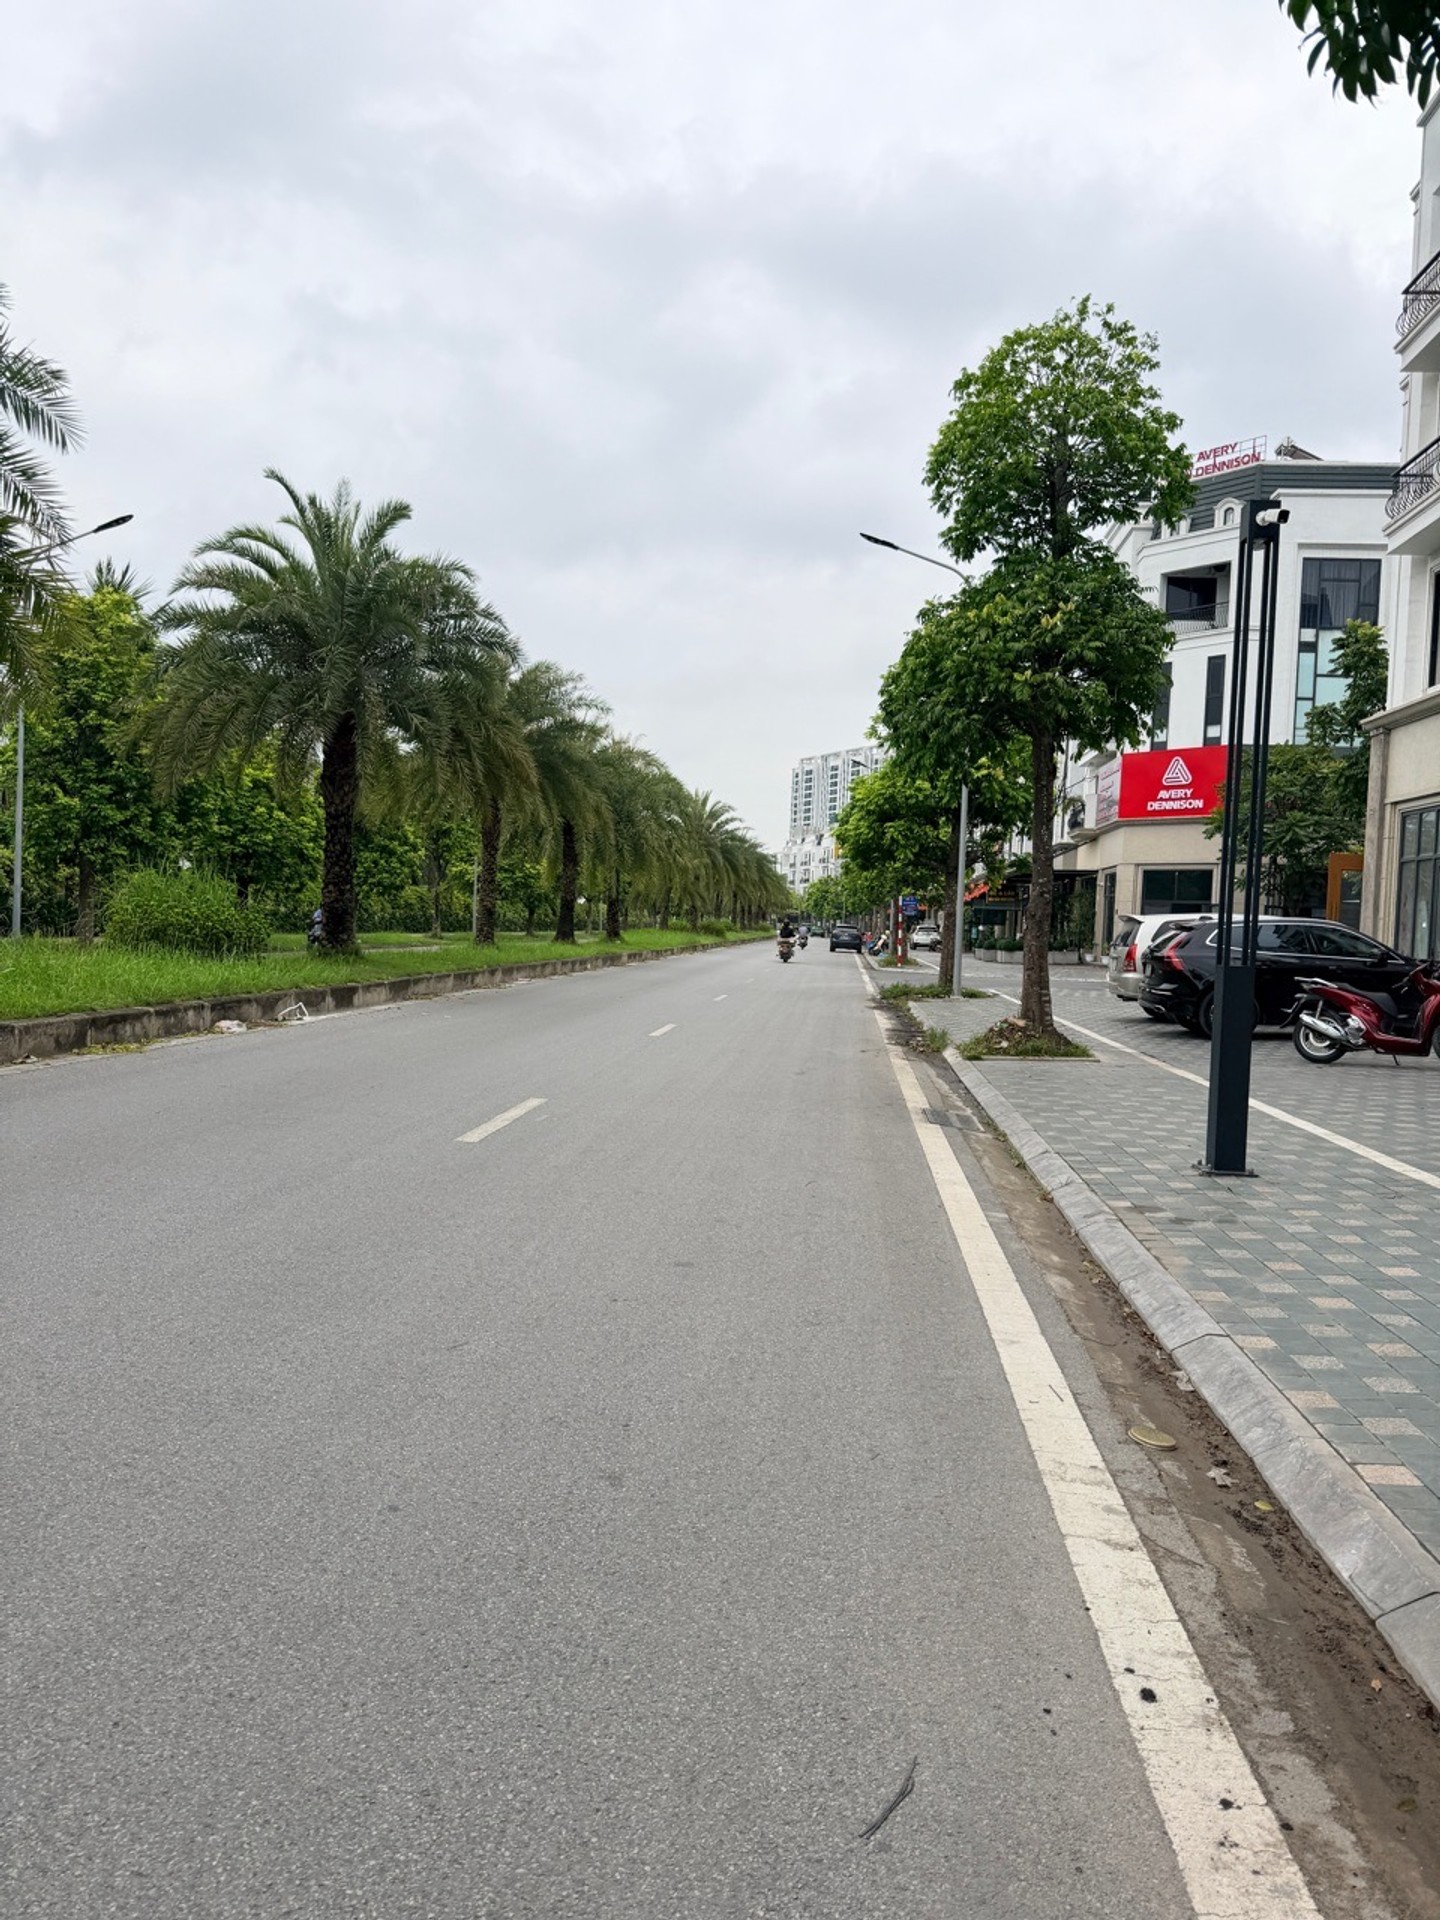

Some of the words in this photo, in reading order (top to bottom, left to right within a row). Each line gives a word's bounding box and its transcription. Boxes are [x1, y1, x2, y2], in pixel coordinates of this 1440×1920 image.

[1197, 442, 1238, 462] AVERY
[1193, 452, 1261, 477] DENNISON
[1157, 789, 1193, 799] AVERY
[1147, 799, 1204, 811] DENNISON
